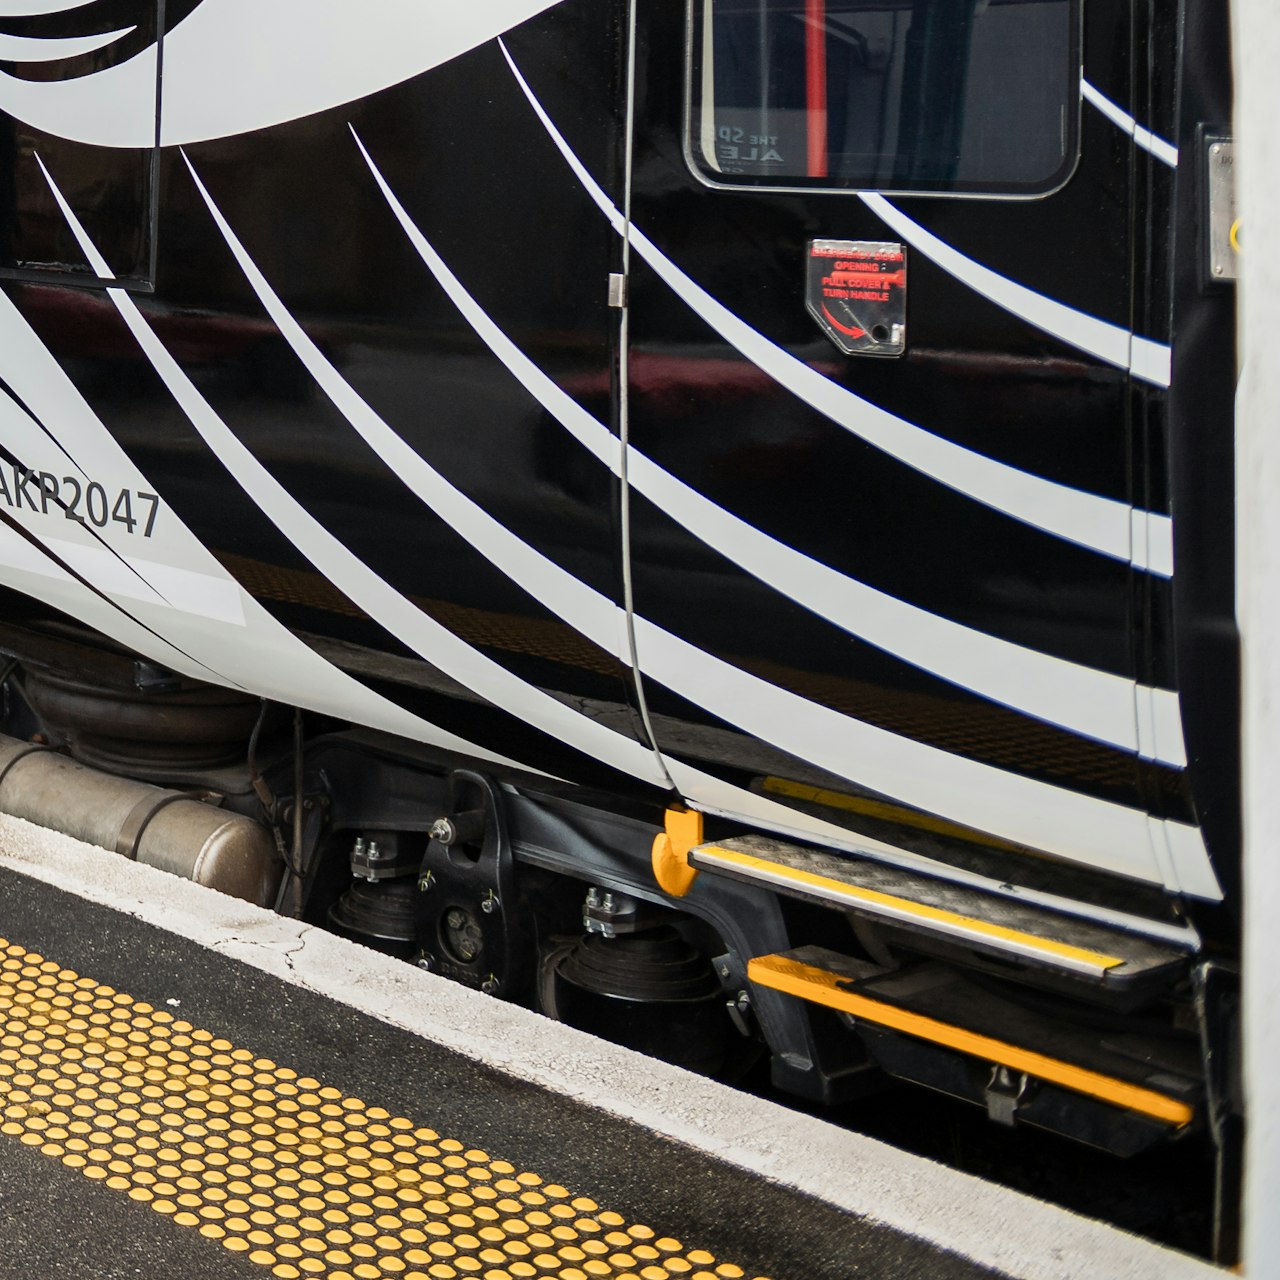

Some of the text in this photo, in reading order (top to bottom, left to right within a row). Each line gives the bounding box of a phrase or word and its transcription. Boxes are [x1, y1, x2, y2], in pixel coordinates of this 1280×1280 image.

[834, 261, 879, 271] OPENING
[822, 277, 847, 286] PULL
[848, 279, 881, 288] COVER
[823, 288, 889, 301] TURN HANDLE
